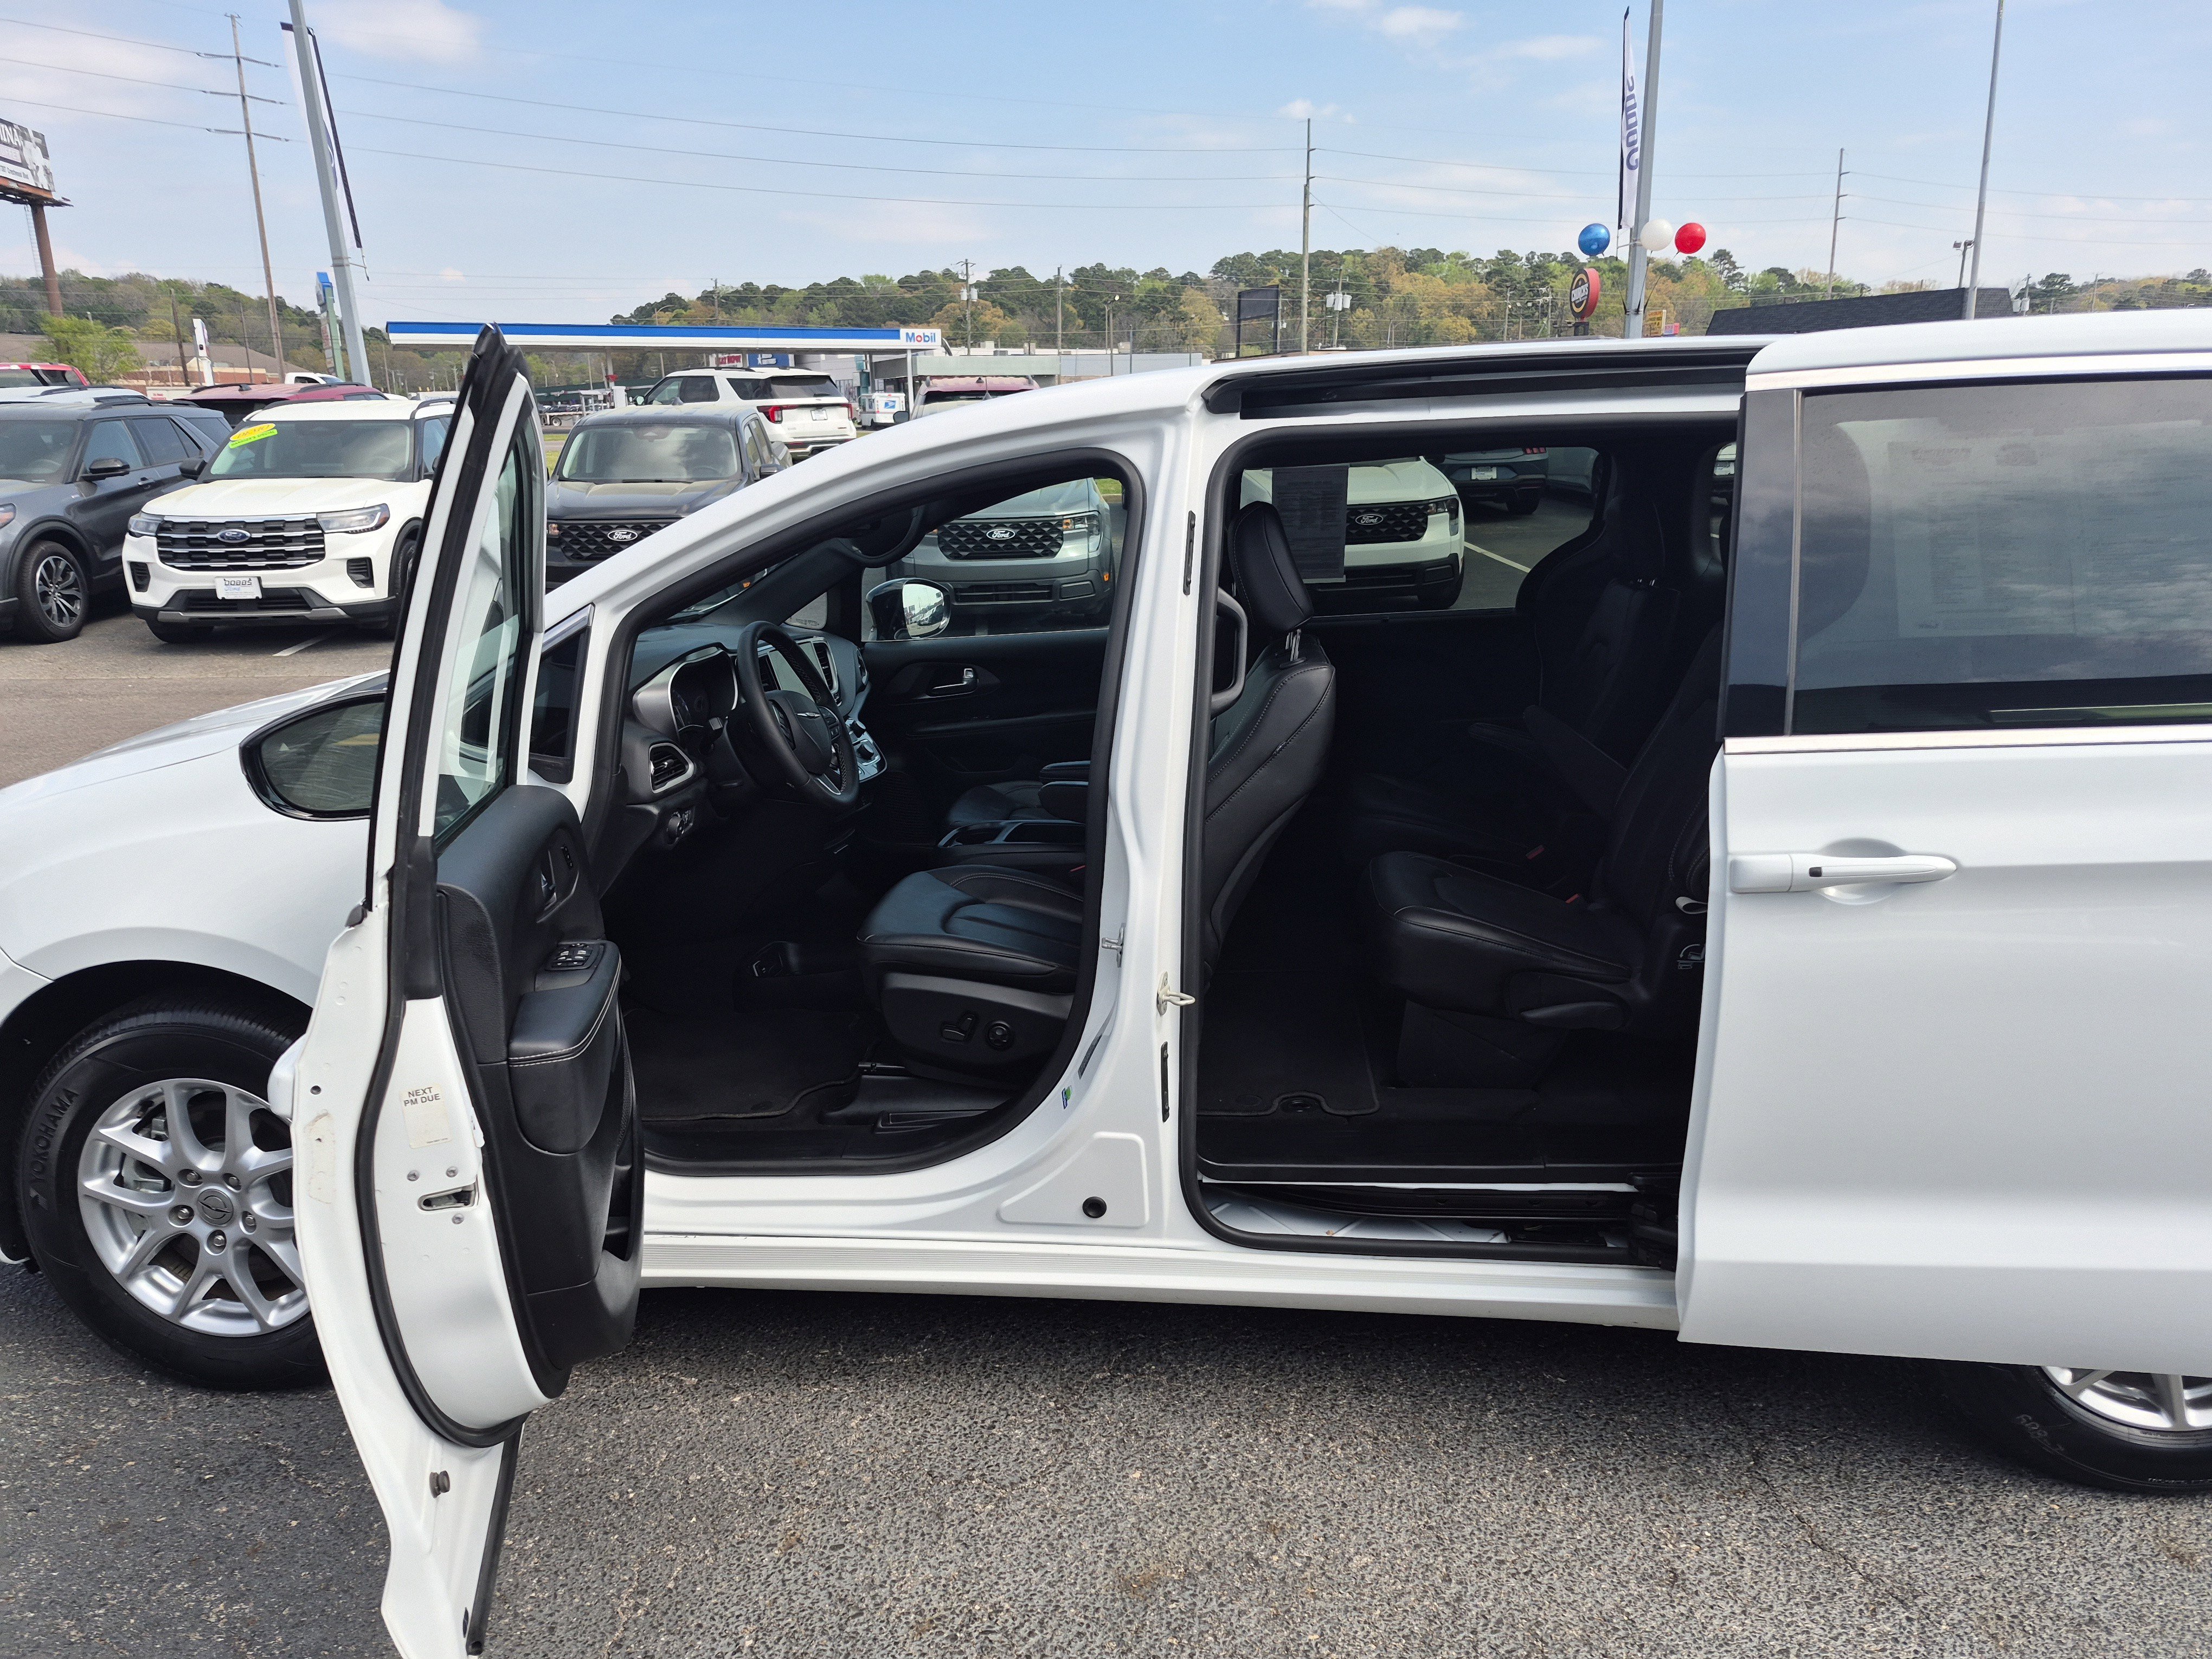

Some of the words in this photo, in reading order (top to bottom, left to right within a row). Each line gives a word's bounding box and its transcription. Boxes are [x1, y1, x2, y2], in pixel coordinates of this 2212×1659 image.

[0, 123, 22, 147] INA
[906, 332, 936, 343] Mobil
[1360, 516, 1379, 524] Ford
[613, 531, 632, 539] Ford
[992, 530, 1010, 538] Ford
[408, 1086, 433, 1098] NEXT
[403, 1098, 418, 1107] PM
[420, 1093, 441, 1104] DUE
[28, 1088, 80, 1184] YOKOHAMA
